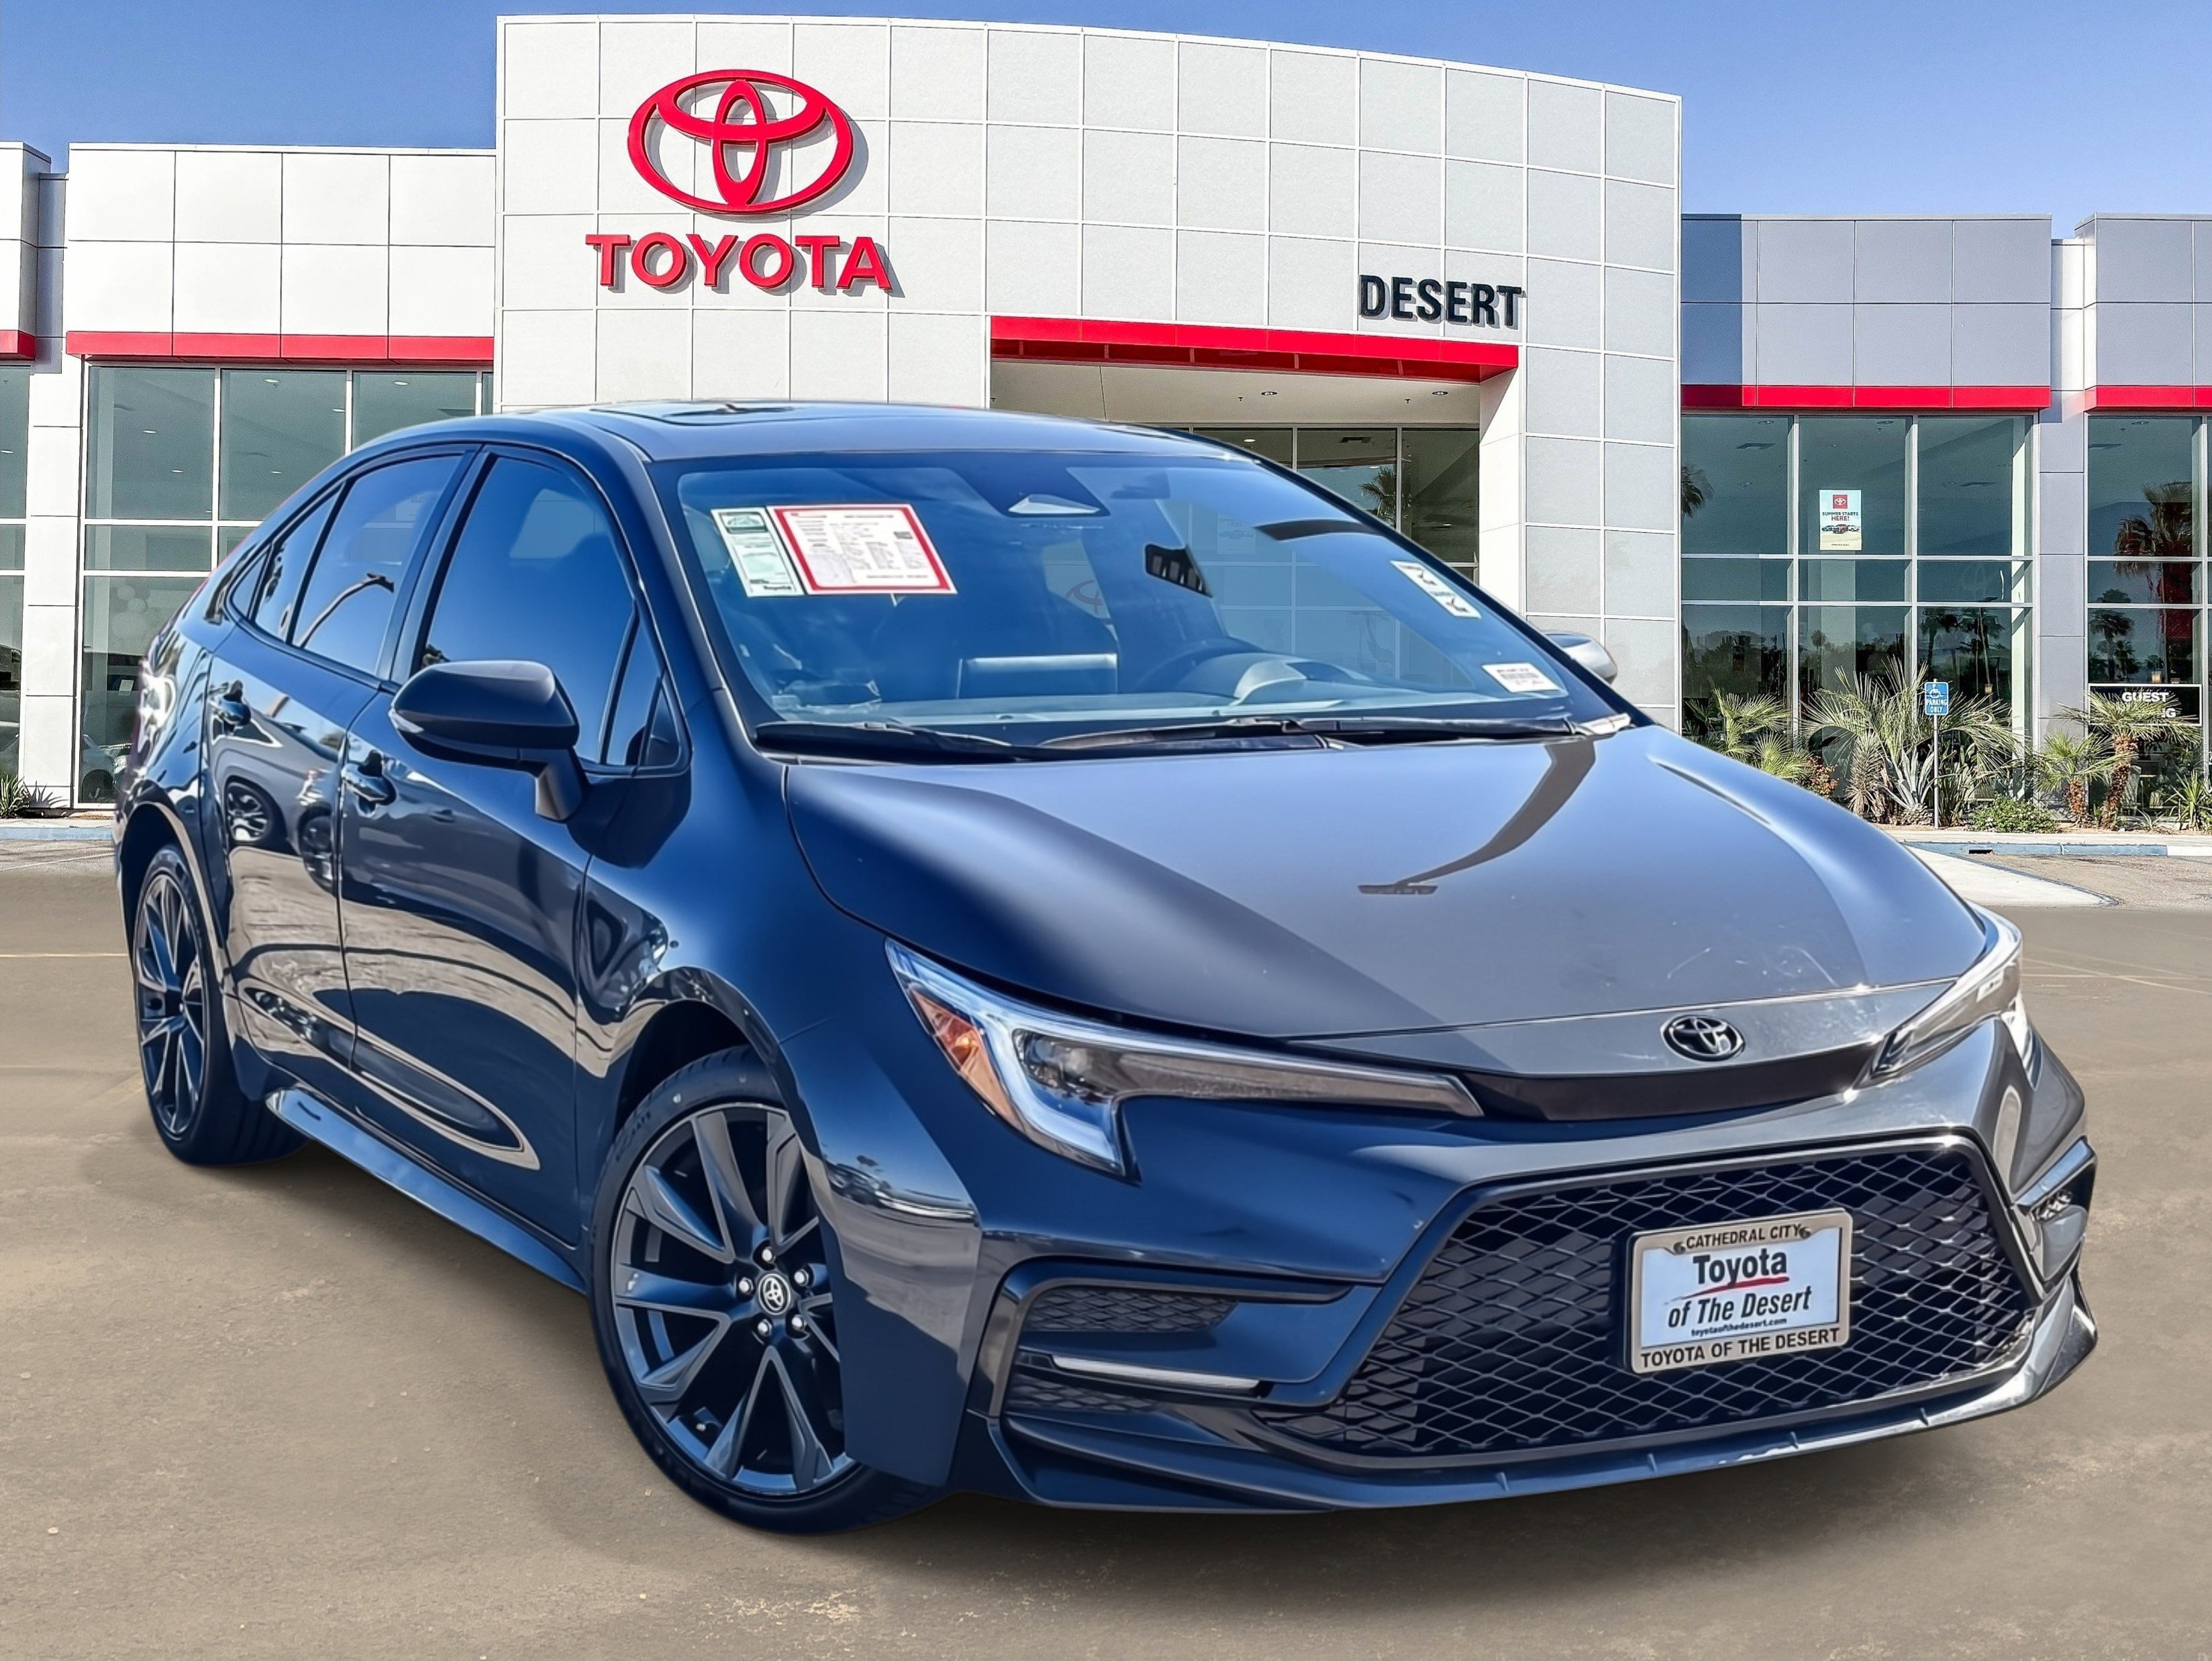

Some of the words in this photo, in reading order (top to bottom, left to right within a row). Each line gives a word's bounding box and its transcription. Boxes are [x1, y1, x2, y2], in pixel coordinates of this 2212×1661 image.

[585, 232, 892, 290] TOYOTA
[1358, 274, 1522, 327] DESERT
[2121, 691, 2169, 703] GUEST
[1686, 1228, 1765, 1249] CATHEDRAL
[1770, 1223, 1801, 1240] CITY
[1693, 1248, 1787, 1286] Toyota
[1668, 1301, 1691, 1327] of
[1697, 1297, 1734, 1324] The
[1741, 1286, 1812, 1317] Desert
[1691, 1317, 1787, 1338] toyotaofthedesert.com
[1641, 1346, 1705, 1368] TOYOTA
[1712, 1342, 1733, 1358] OF
[1740, 1336, 1771, 1354] THE
[1776, 1327, 1840, 1350] DESERT
